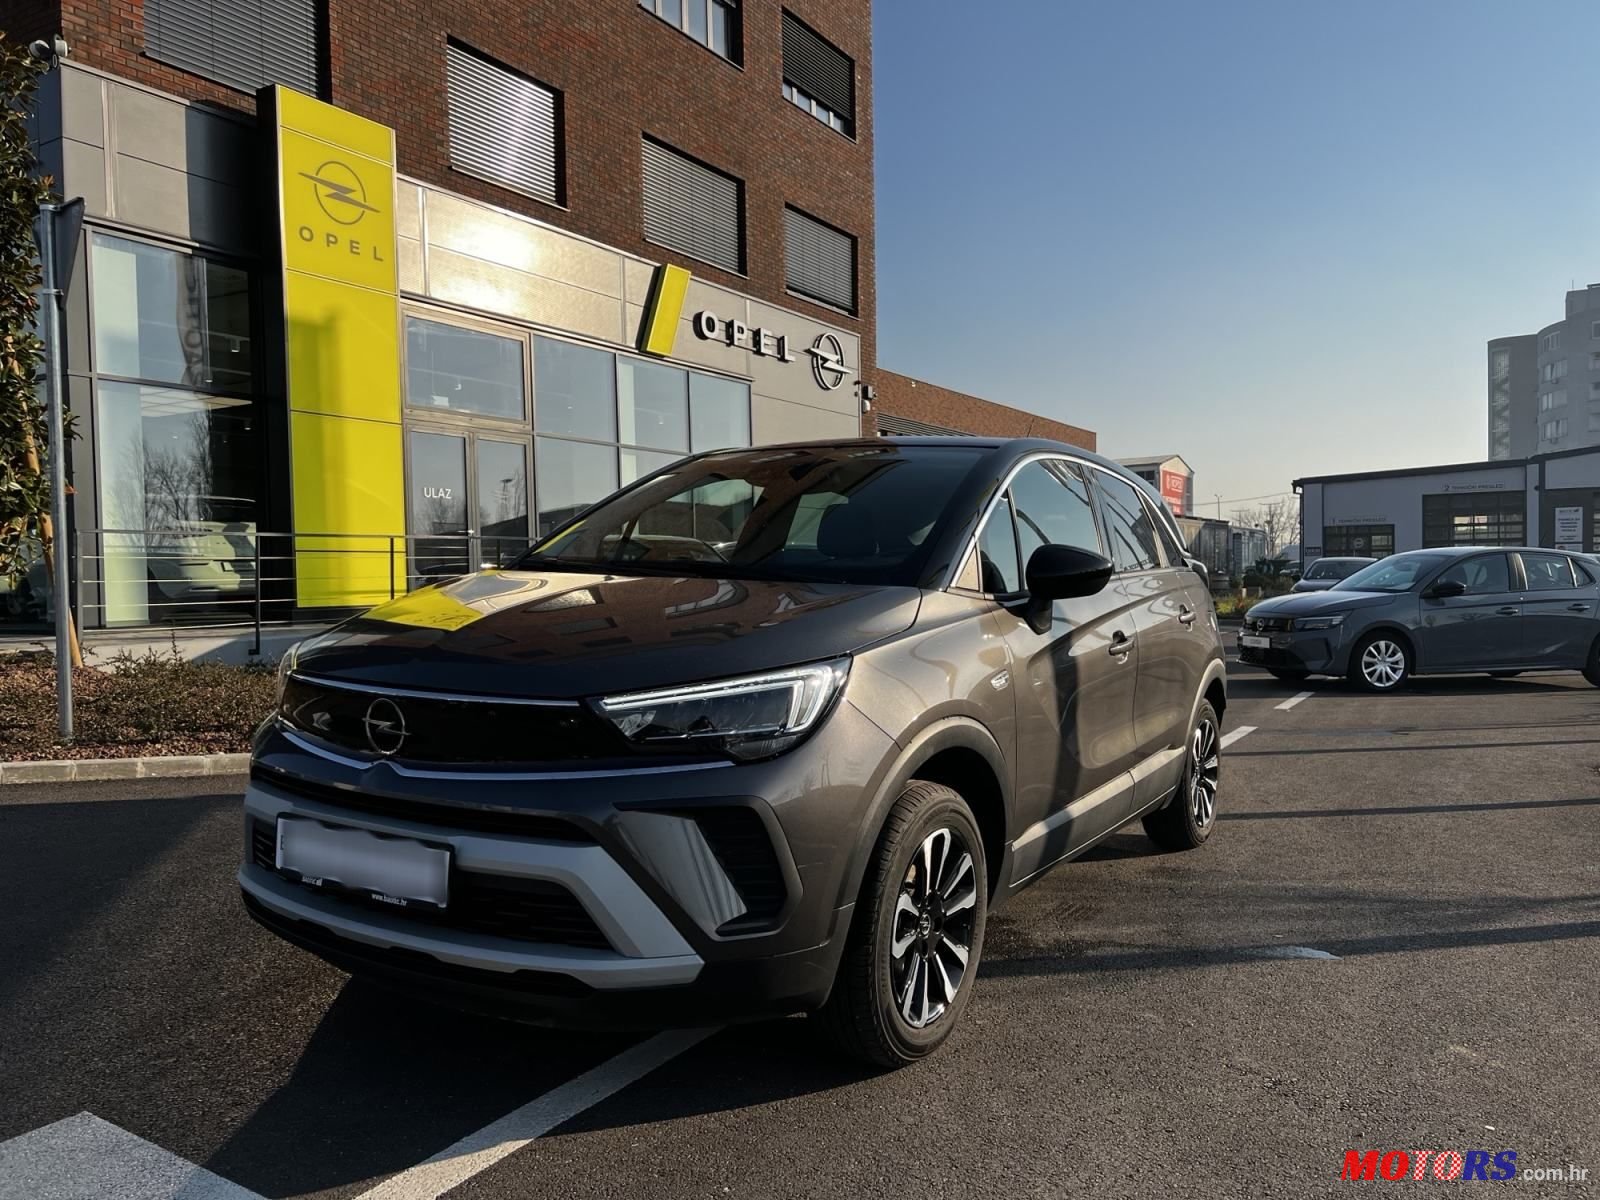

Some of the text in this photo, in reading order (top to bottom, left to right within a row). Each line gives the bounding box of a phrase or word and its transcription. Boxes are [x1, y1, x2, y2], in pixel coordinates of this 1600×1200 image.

[298, 226, 384, 262] OPEL
[693, 310, 796, 363] OPEL
[424, 487, 452, 499] ULAZ
